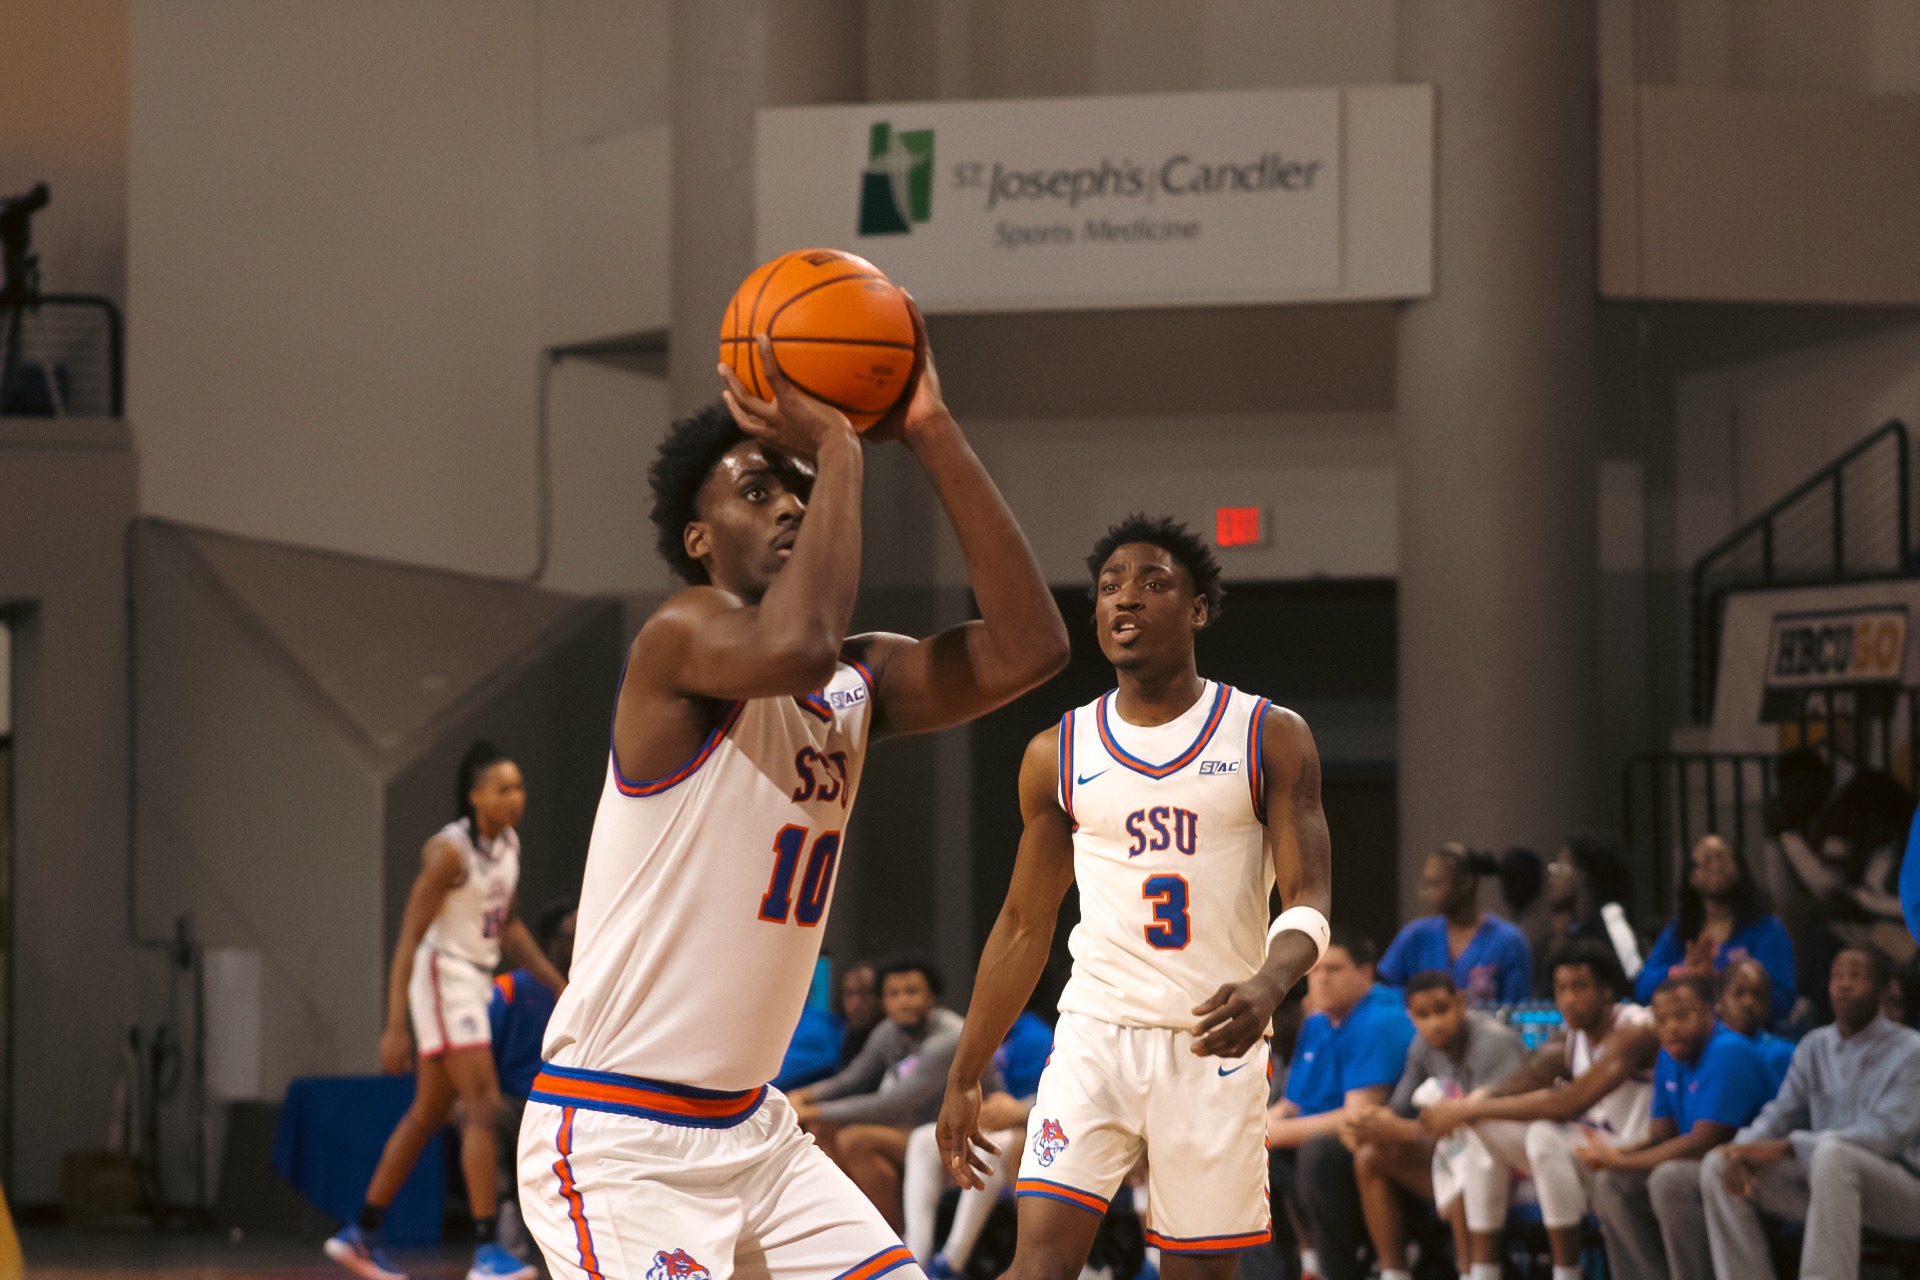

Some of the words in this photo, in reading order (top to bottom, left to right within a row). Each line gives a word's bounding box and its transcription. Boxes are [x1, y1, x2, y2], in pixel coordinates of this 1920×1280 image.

[1160, 152, 1321, 194] Candler
[995, 219, 1074, 249] Sports
[1083, 216, 1200, 242] Medicine
[1125, 806, 1198, 858] SSU
[757, 823, 840, 927] 10
[1142, 873, 1191, 950] 3
